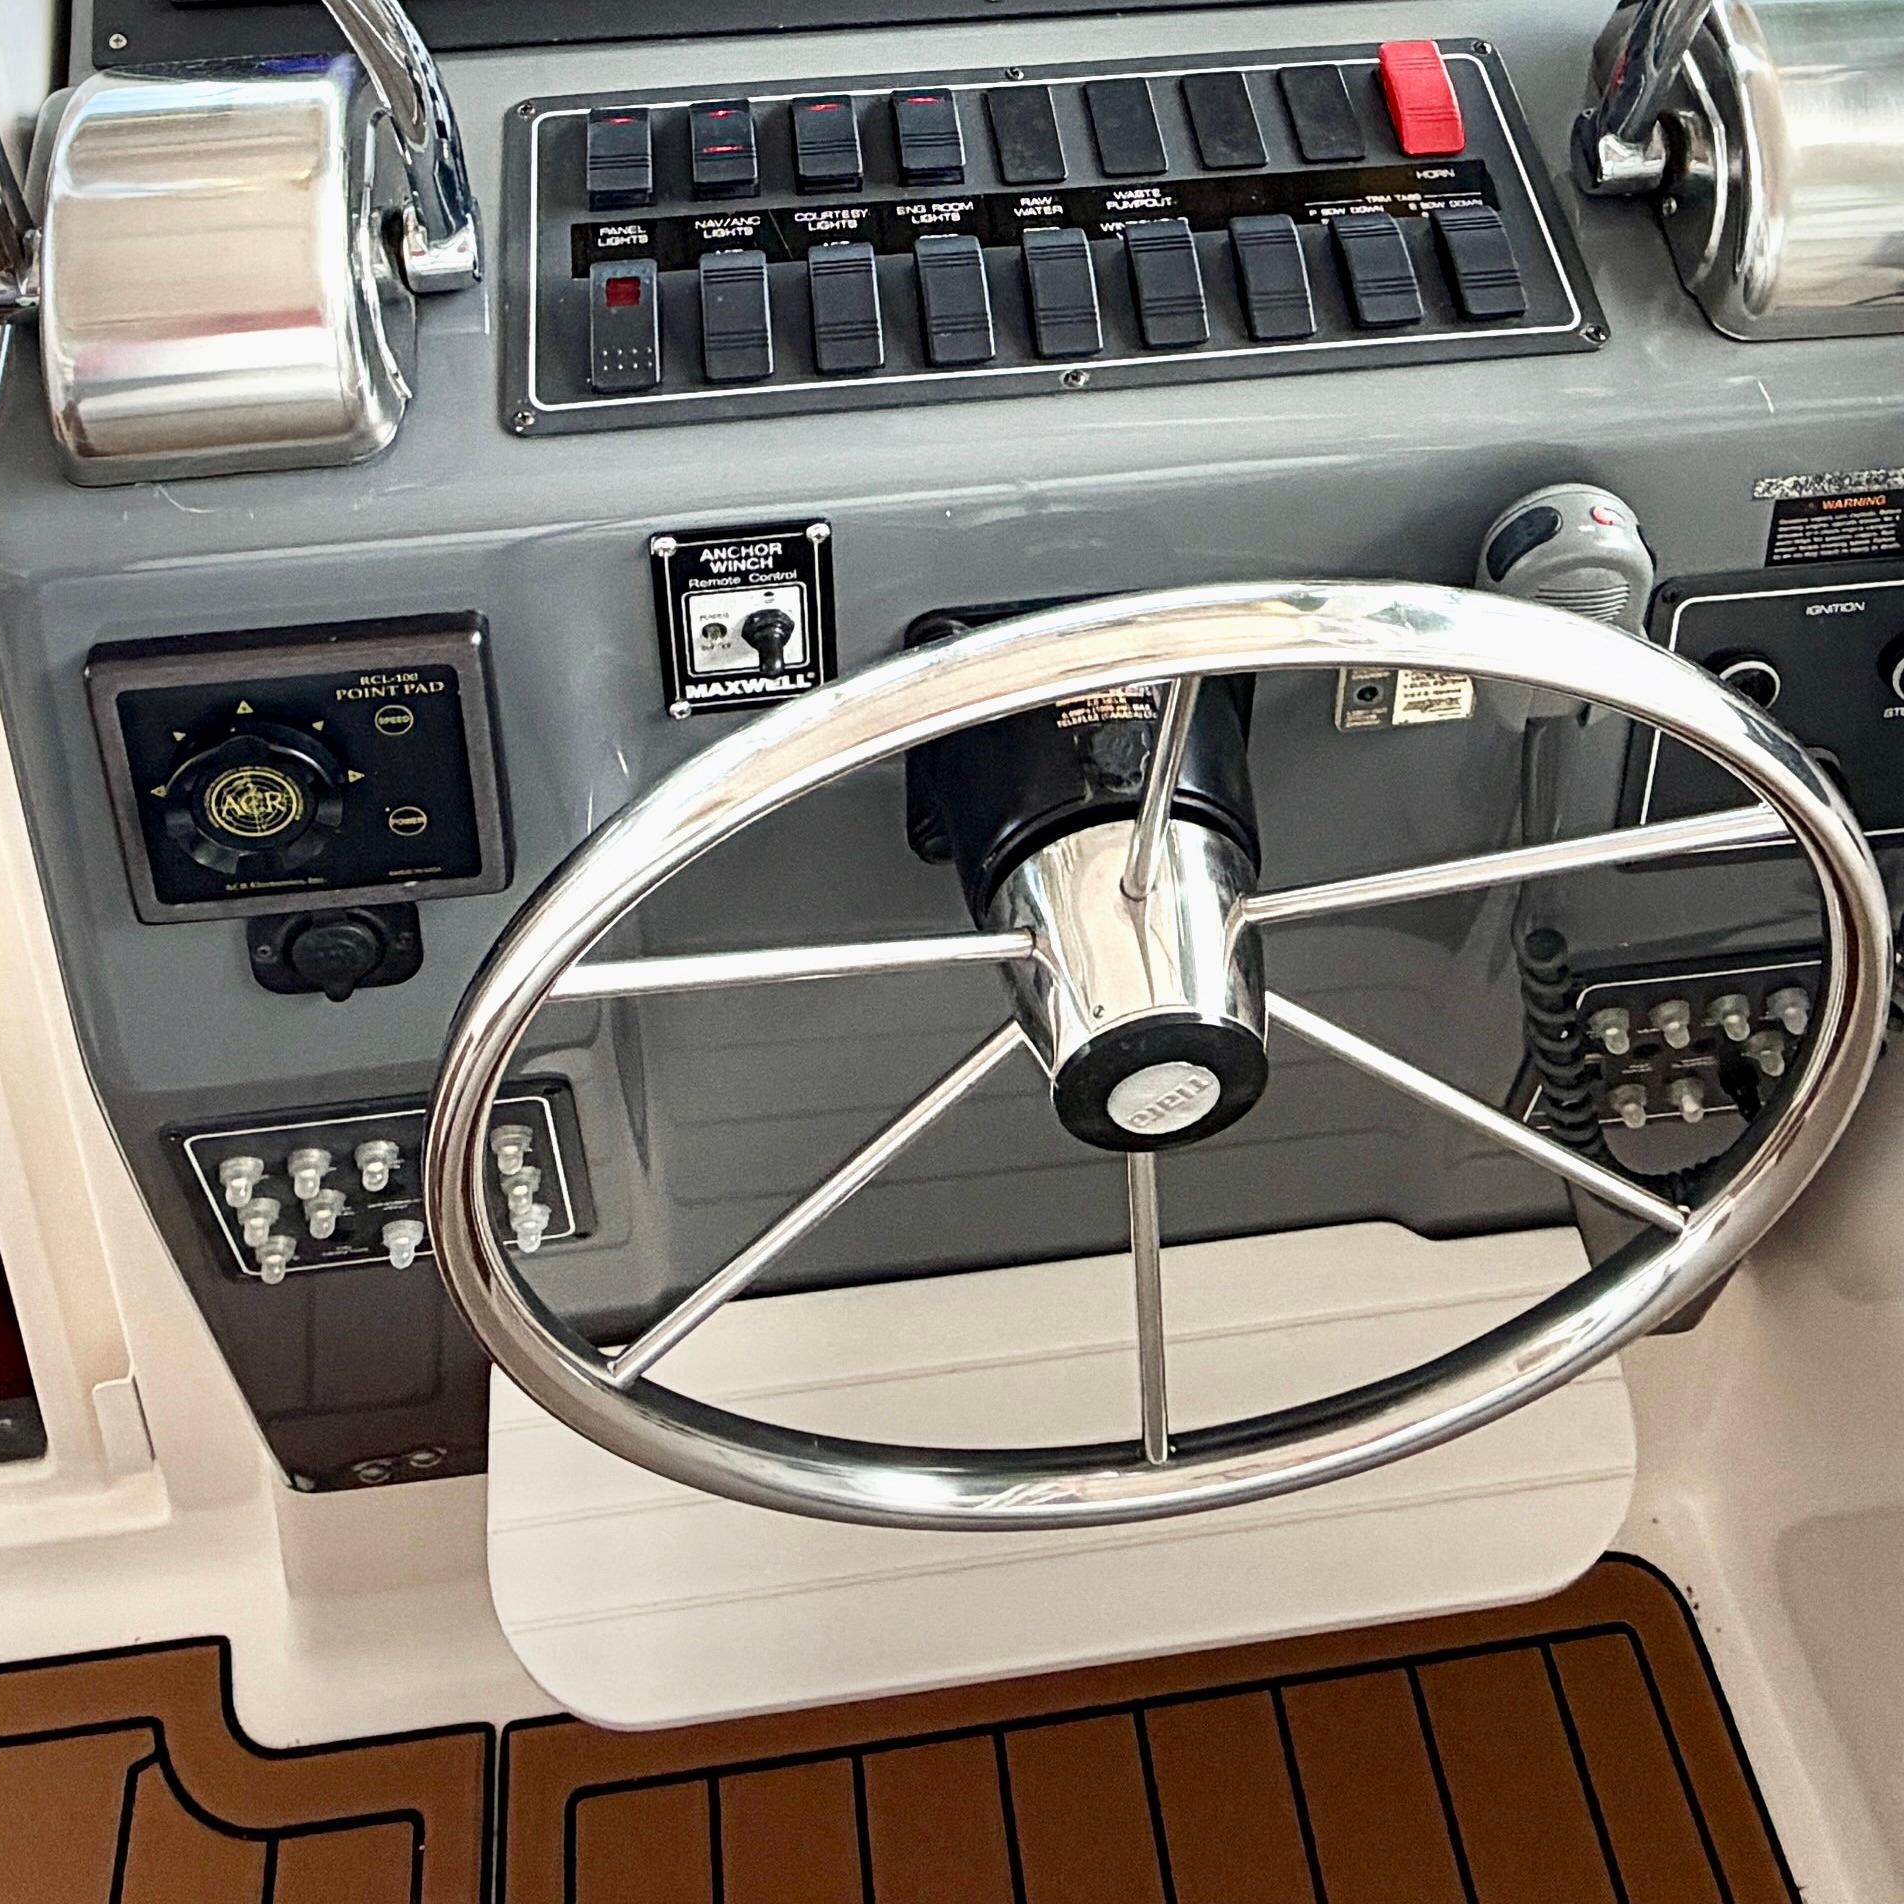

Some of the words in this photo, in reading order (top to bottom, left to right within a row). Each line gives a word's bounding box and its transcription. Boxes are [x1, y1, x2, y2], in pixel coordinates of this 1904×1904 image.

[1416, 168, 1456, 179] HORN
[1020, 196, 1053, 206] RAW
[1113, 188, 1162, 200] WASTE
[795, 208, 869, 223] COURTESY
[896, 205, 927, 216] ENG
[932, 201, 974, 212] ROOM
[1014, 205, 1063, 217] WATER
[695, 216, 761, 230] NAV/ANC
[911, 212, 961, 224] LIGHTS
[599, 225, 647, 237] PANEL
[703, 226, 754, 239] LIGHTS
[808, 219, 858, 232] LIGHTS
[597, 234, 649, 247] LIGHTS
[1822, 495, 1887, 510] WARNING
[699, 542, 783, 563] ANCHOR
[709, 556, 774, 574] WINCH
[688, 576, 741, 589] Remote
[748, 569, 797, 583] Control
[1805, 600, 1866, 616] IGNITION
[336, 684, 399, 701] POINT
[403, 681, 445, 695] PAD
[684, 673, 813, 700] MAXWELL
[378, 714, 410, 726] SPEED
[222, 791, 287, 817] ACR
